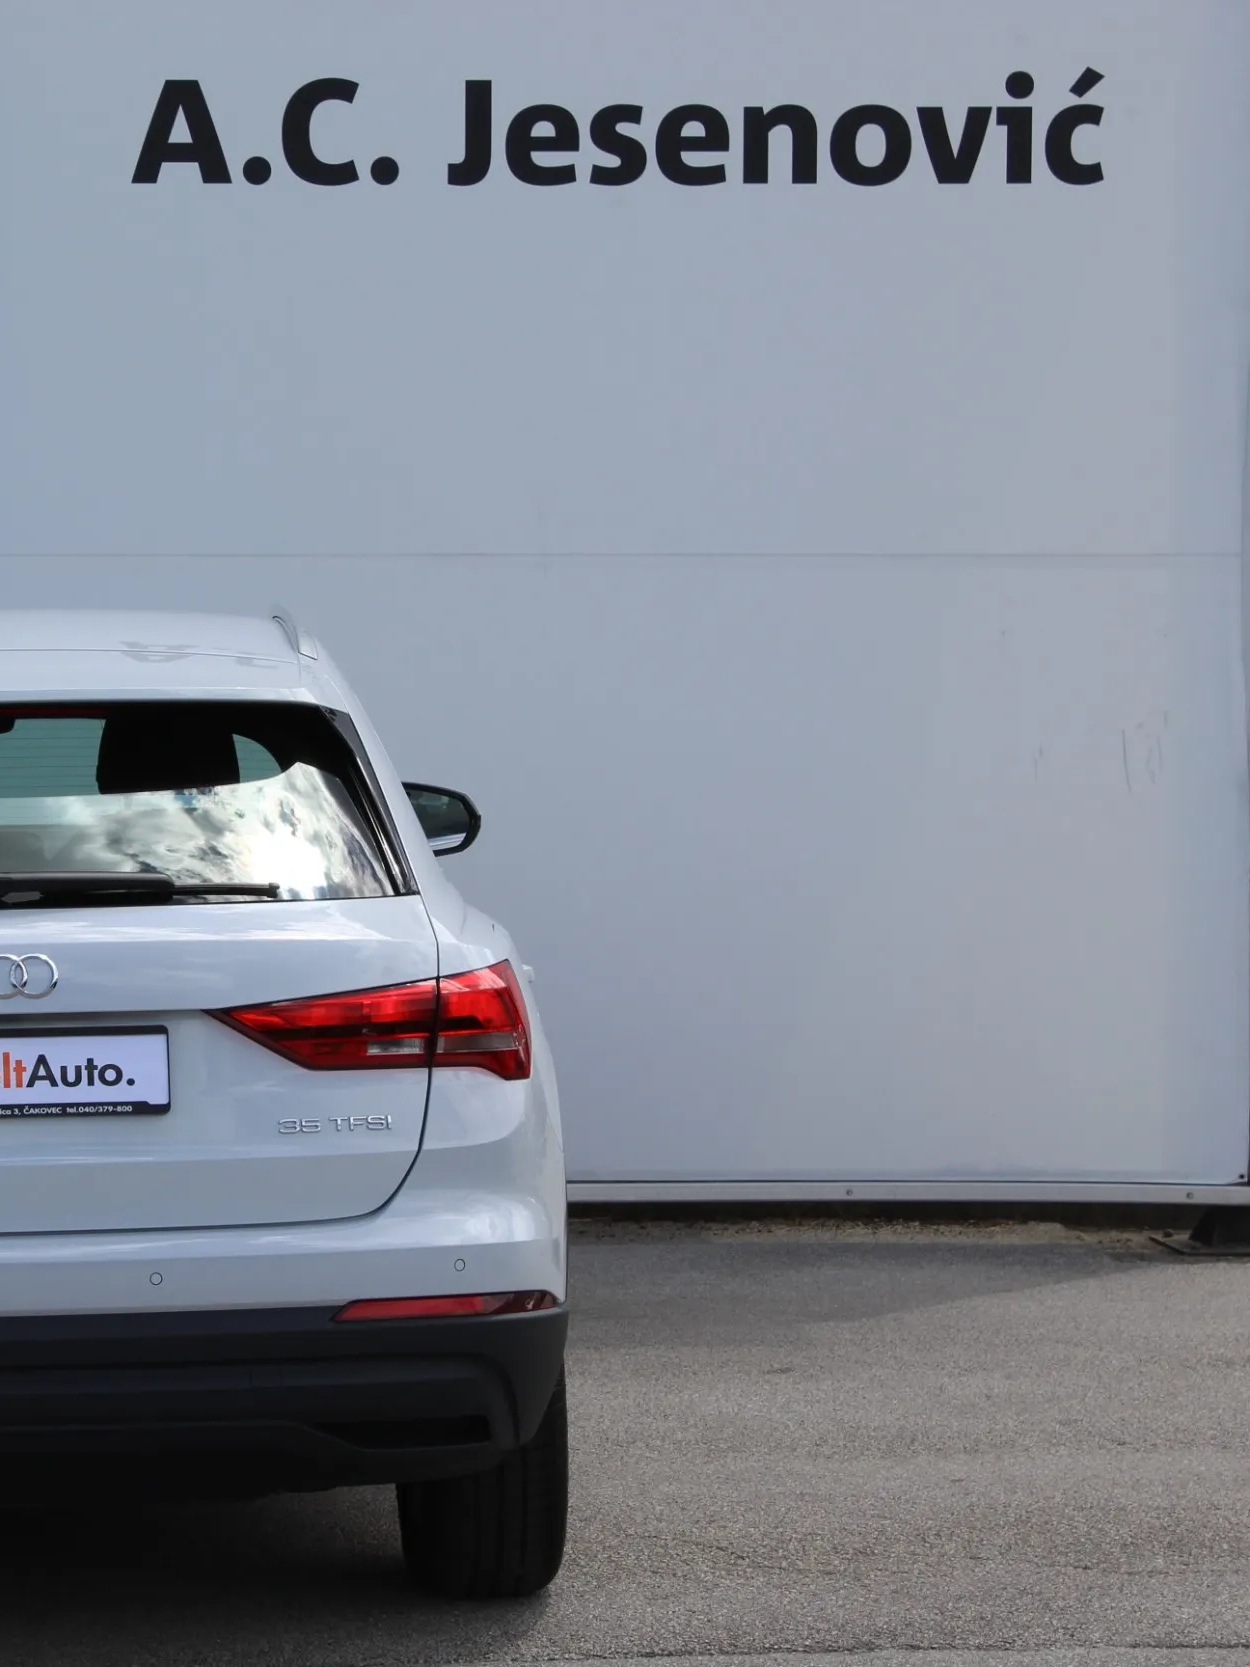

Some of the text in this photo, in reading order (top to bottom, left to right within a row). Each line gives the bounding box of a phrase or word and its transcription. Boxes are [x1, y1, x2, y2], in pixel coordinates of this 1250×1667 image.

[131, 67, 1105, 186] A.C. Jesenović
[23, 1105, 62, 1115] ČAKOVEC
[278, 1115, 392, 1134] 35 TFSI
